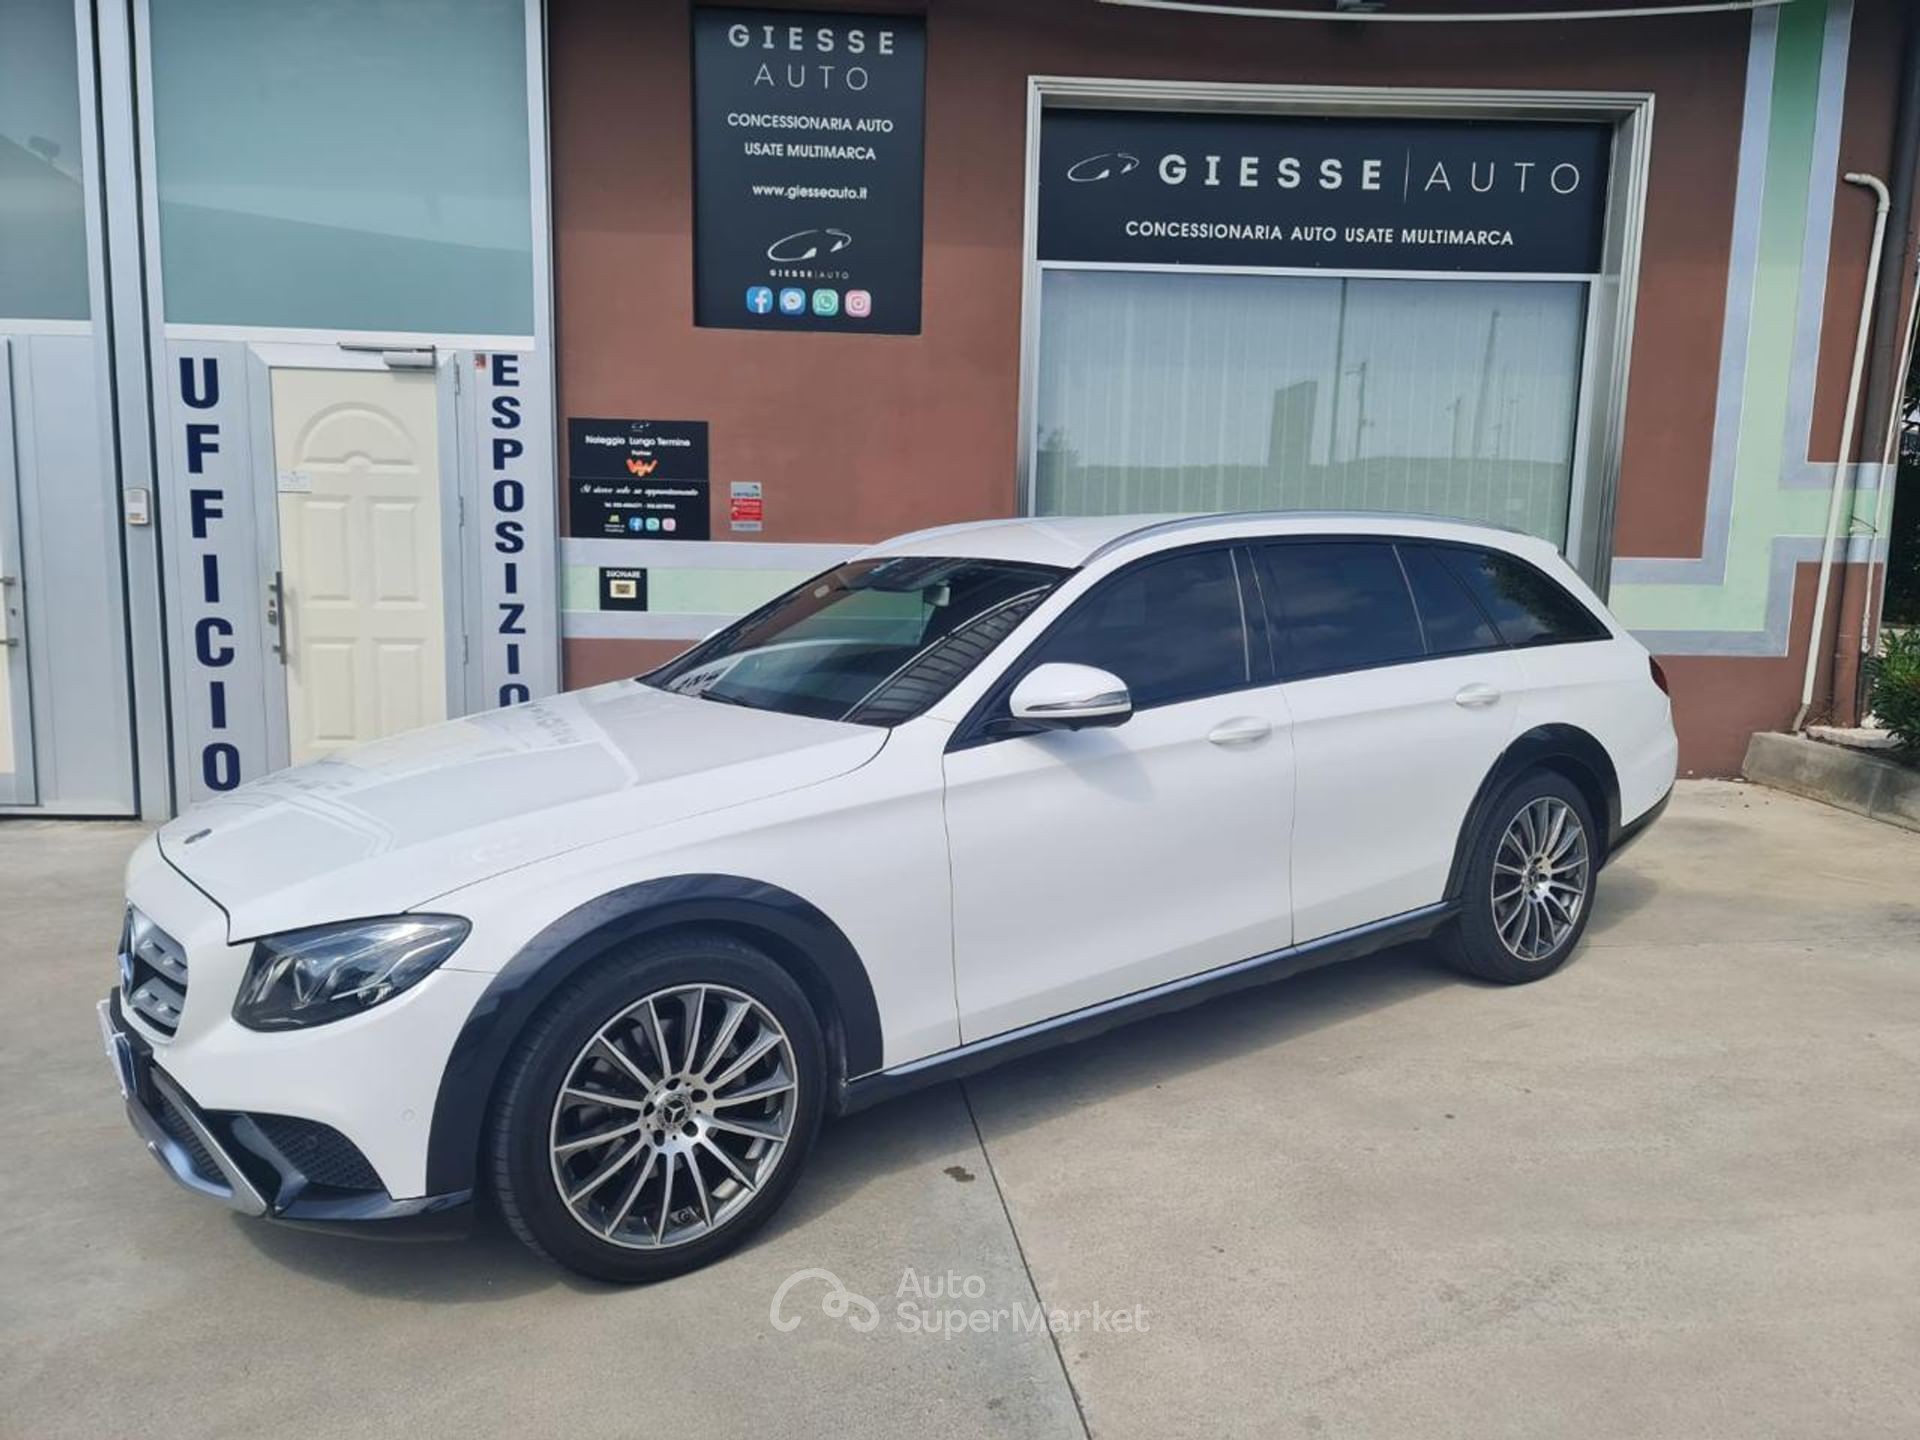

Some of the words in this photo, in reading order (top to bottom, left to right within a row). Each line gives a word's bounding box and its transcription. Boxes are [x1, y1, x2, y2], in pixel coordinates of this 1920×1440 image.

[728, 24, 894, 55] GIESSE
[754, 63, 869, 91] AUTO
[727, 113, 853, 131] CONCESSIONARIA
[856, 118, 894, 133] AUTO
[744, 142, 784, 157] USATE
[787, 143, 876, 161] MULTIMARCA
[1158, 153, 1382, 191] GIESSE
[1424, 160, 1581, 195] AUTO
[752, 184, 868, 200] www.giesseauto.it
[1125, 220, 1283, 241] CONCESSIONARIA
[1290, 225, 1337, 242] AUTO
[1344, 226, 1394, 244] USATE
[1401, 229, 1514, 246] MULTIMARCA
[769, 269, 812, 278] GIESSE
[820, 271, 849, 279] AUTO
[629, 436, 656, 447] Lungo
[657, 437, 691, 447] Termine
[179, 356, 241, 792] UFFICIO
